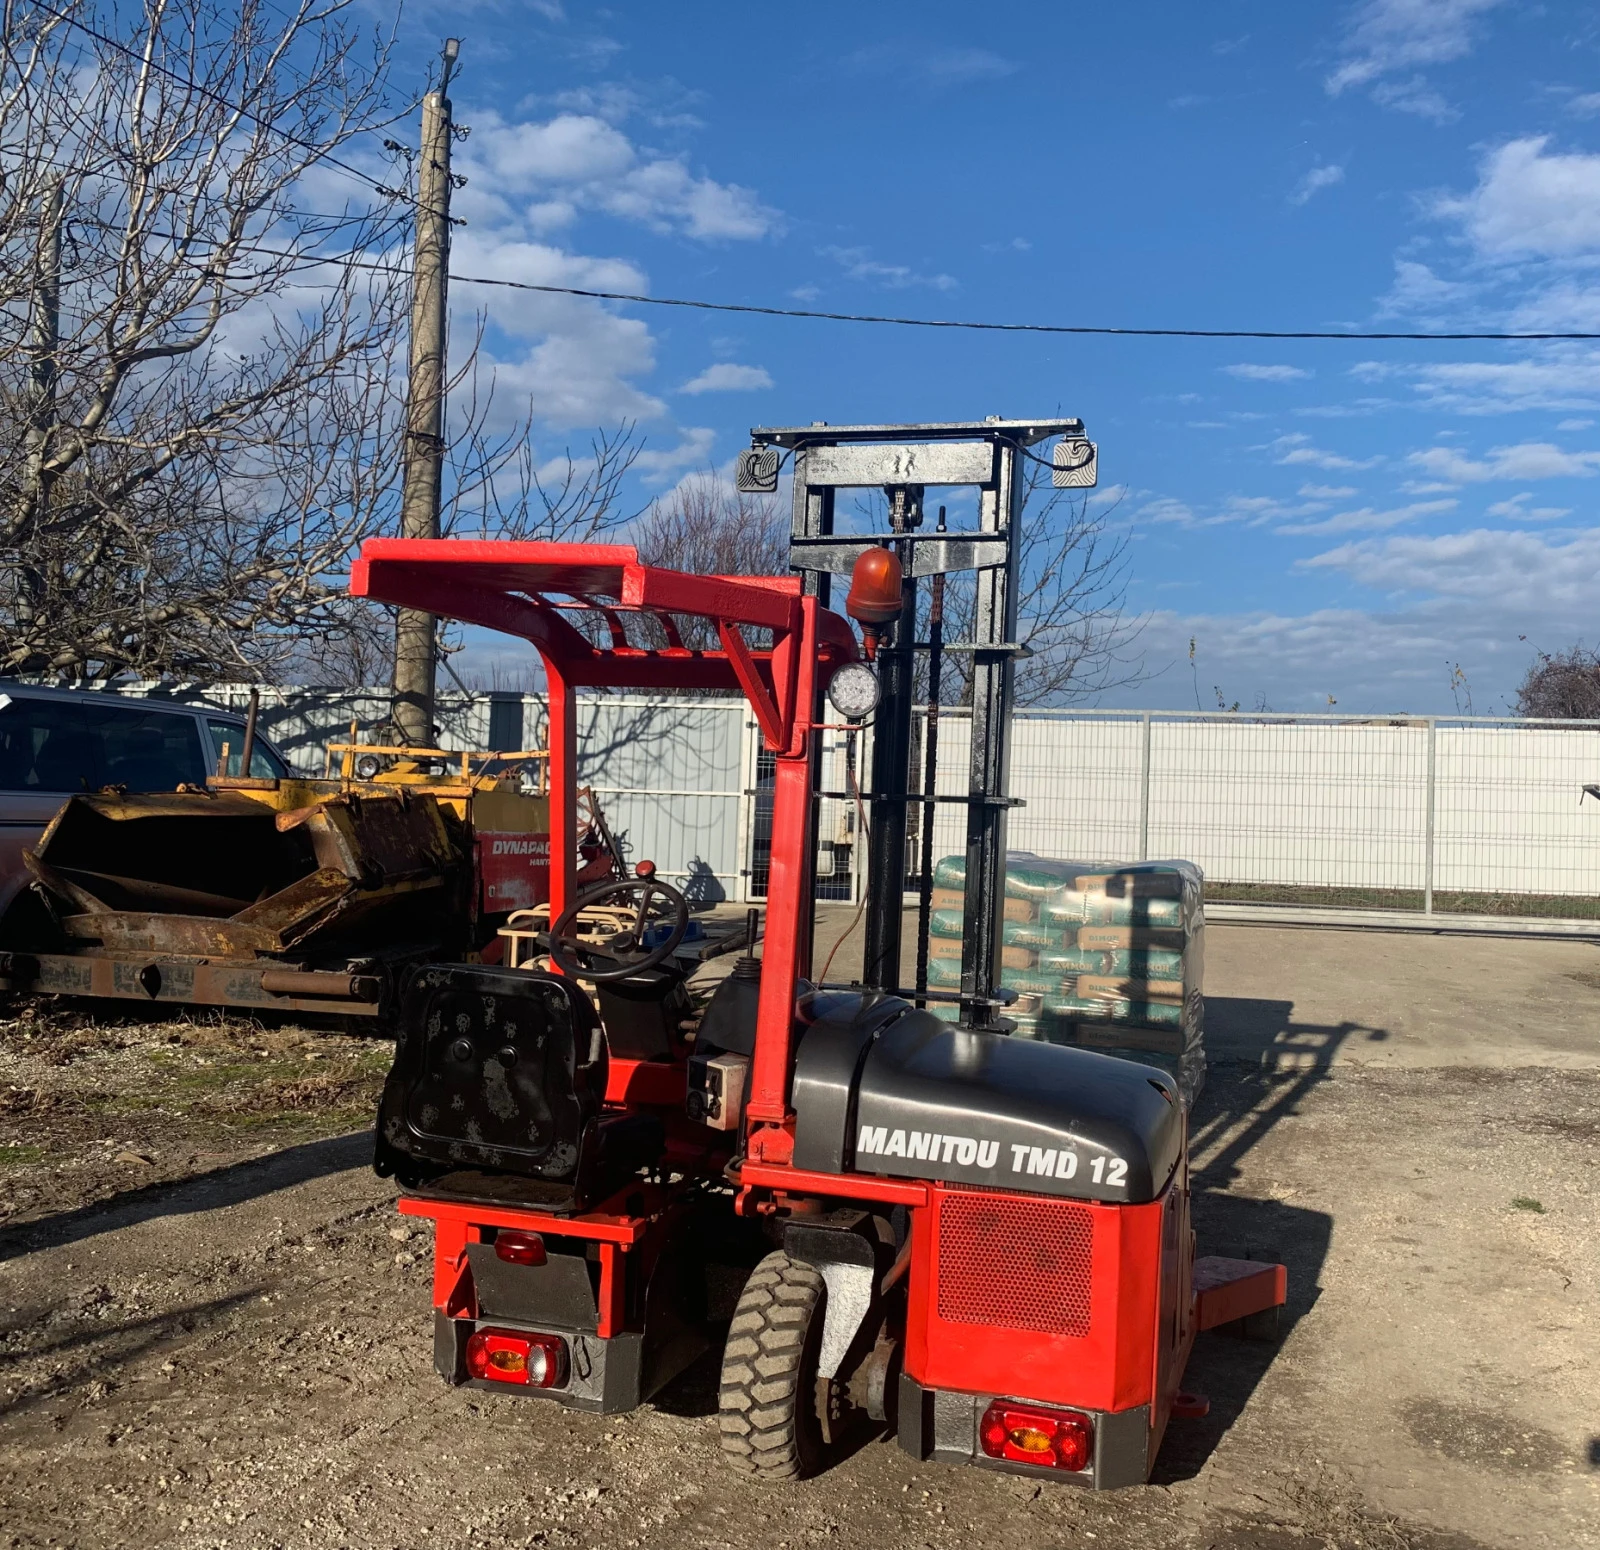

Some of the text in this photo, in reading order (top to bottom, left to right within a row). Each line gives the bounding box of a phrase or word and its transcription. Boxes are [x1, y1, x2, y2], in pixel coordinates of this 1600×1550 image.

[857, 1126, 1128, 1187] MANITOU TMD 12
